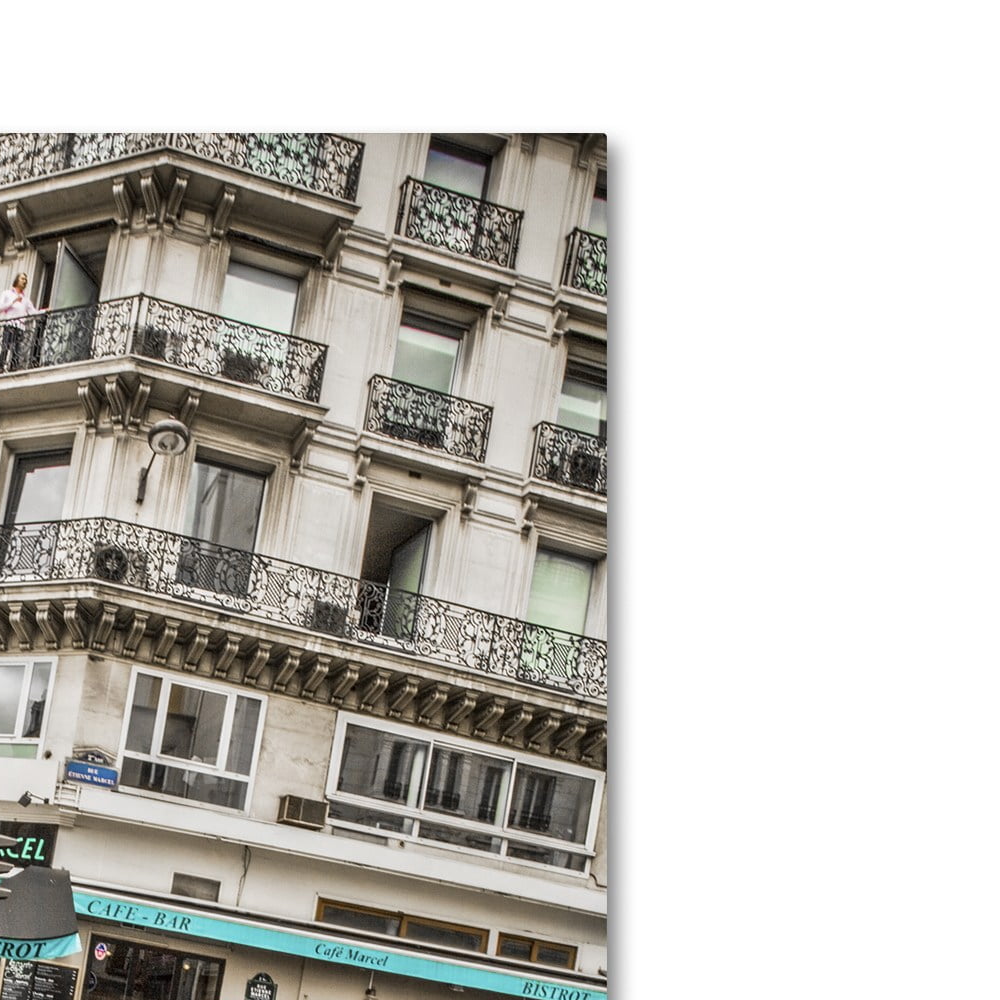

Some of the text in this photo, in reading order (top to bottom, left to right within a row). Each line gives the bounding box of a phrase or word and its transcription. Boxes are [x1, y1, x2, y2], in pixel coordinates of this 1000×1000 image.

[154, 911, 192, 931] BAR
[315, 943, 389, 967] Café Marcel
